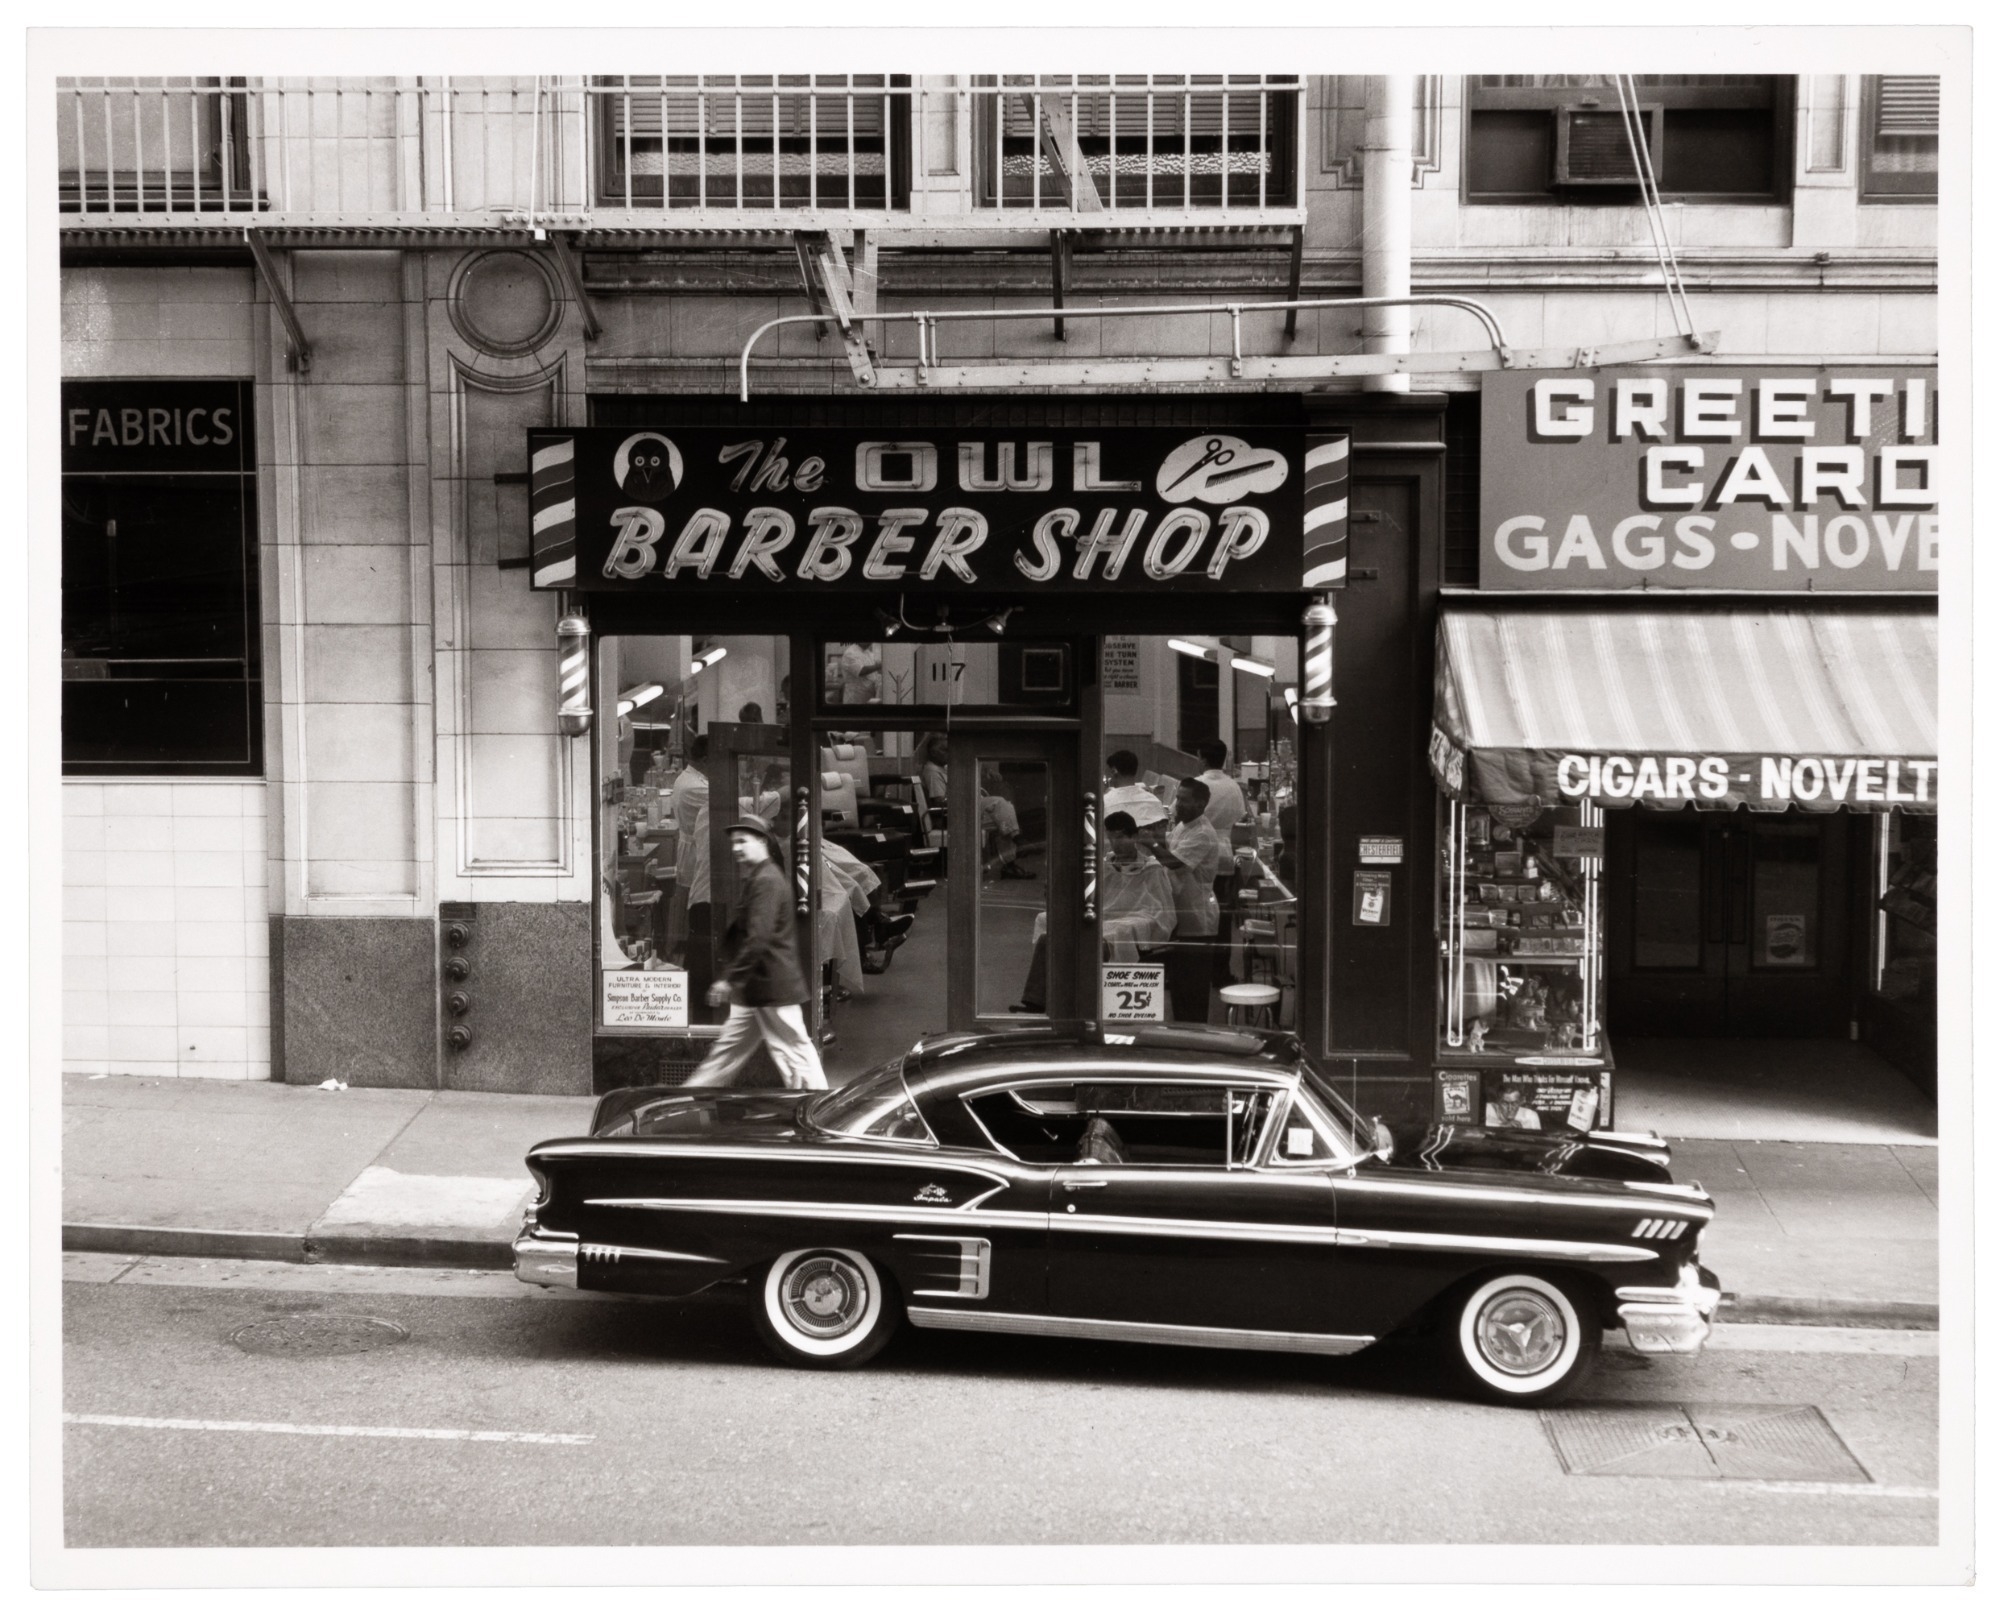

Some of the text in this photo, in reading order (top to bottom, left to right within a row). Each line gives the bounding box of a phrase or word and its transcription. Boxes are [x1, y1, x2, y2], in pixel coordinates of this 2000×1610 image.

[1530, 378, 1937, 440] GREETI
[69, 408, 234, 446] FABRICS
[718, 436, 1142, 494] The OWL
[602, 505, 1271, 584] BARBER SHOP
[1494, 514, 1718, 572] GAGS
[931, 662, 967, 683] 117
[1114, 681, 1138, 689] BARBER
[1557, 755, 1730, 799] CIGARS
[1760, 757, 1938, 802] NOVELT
[1106, 971, 1161, 980] SHOE SHINE
[630, 993, 649, 1003] Barber
[651, 993, 672, 1005] Supply
[1116, 990, 1152, 1010] 25¢
[1438, 1070, 1477, 1082] Cigarettes
